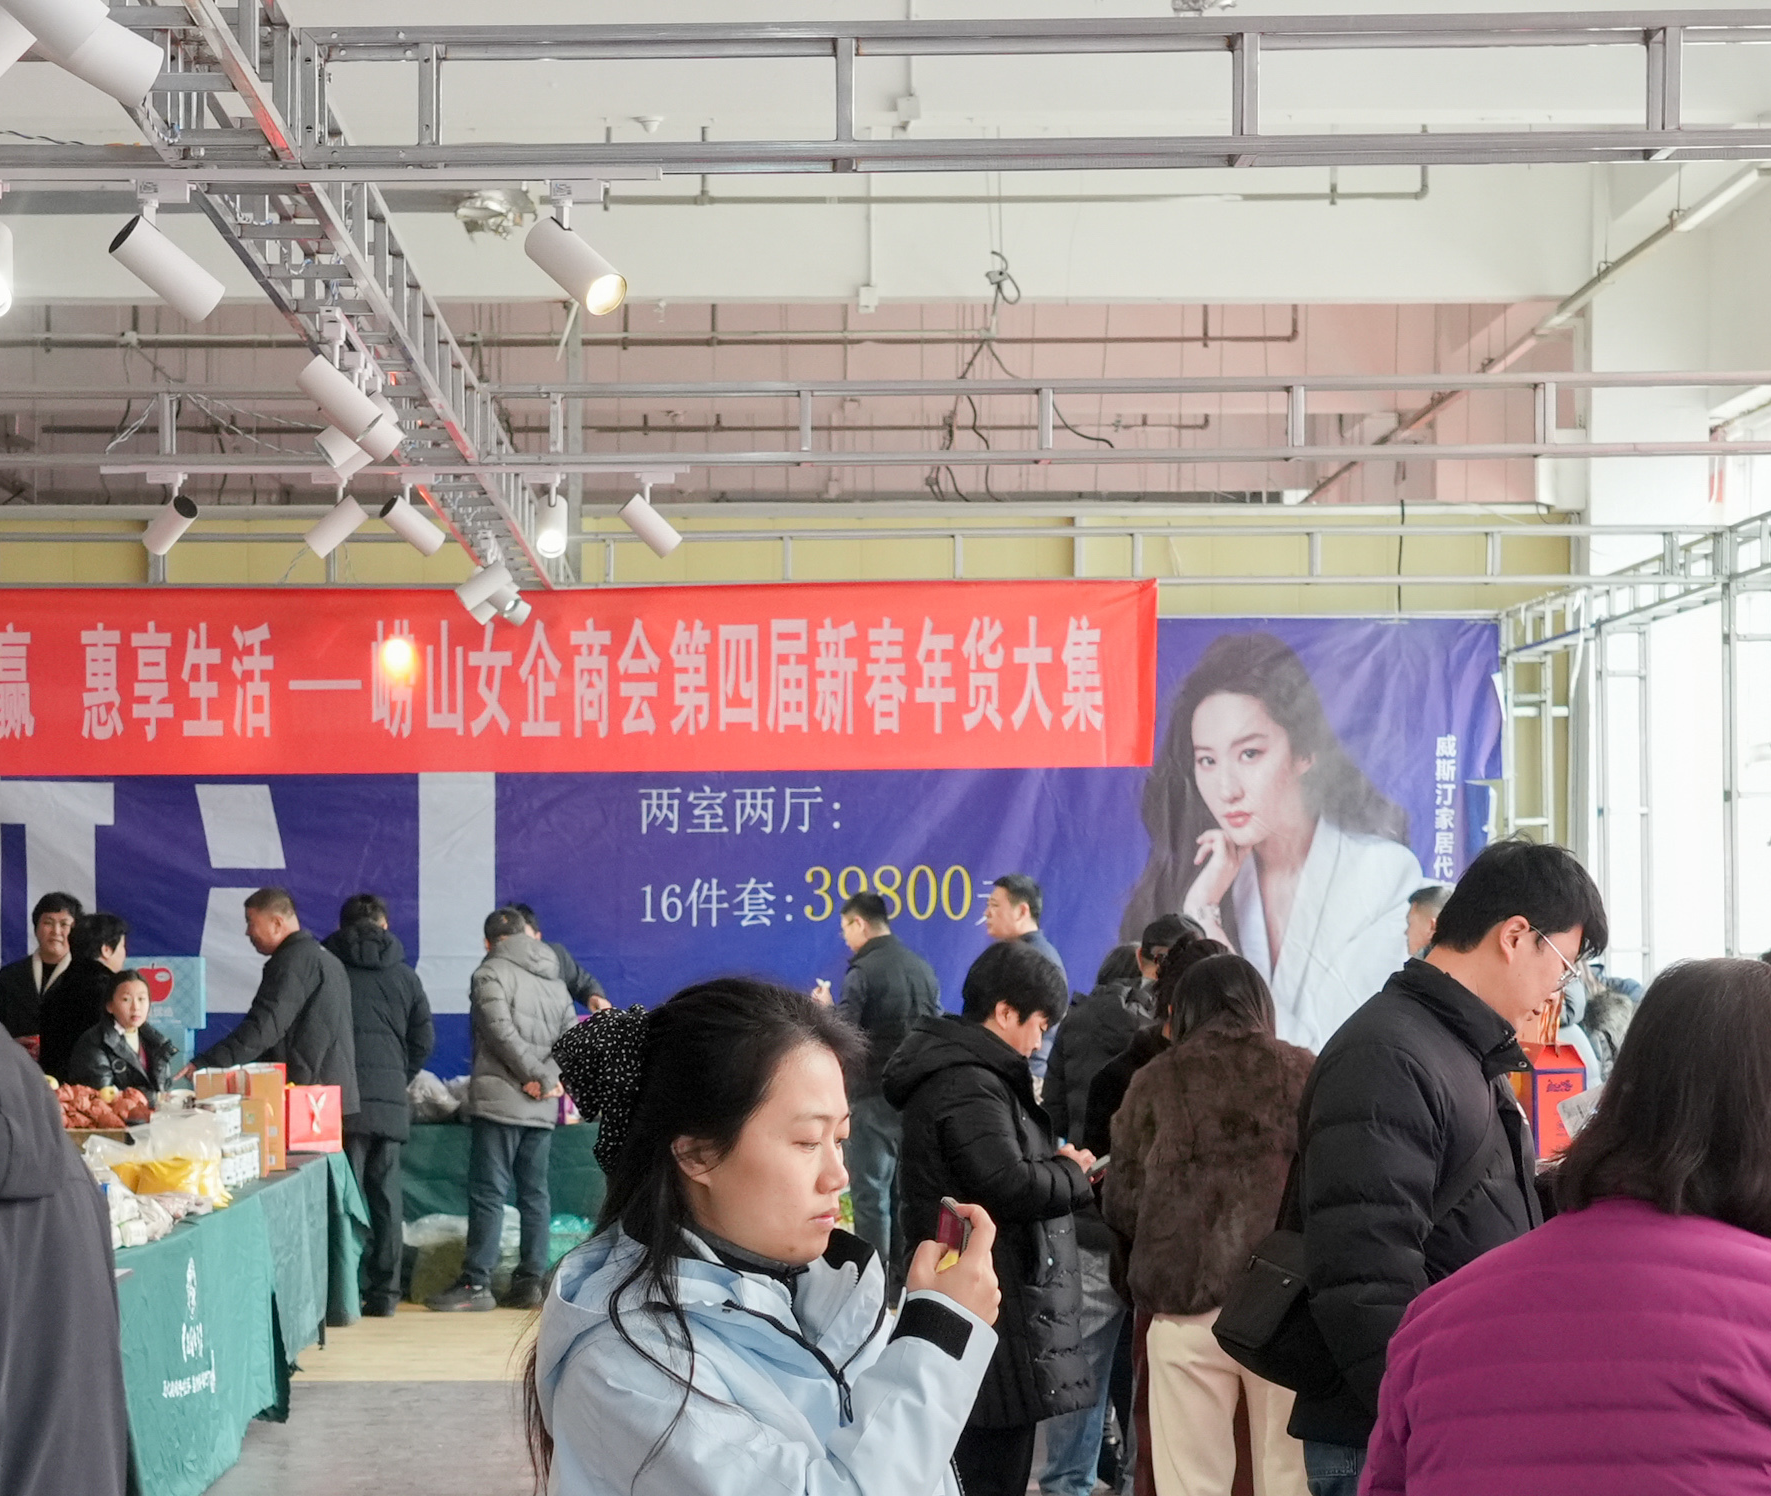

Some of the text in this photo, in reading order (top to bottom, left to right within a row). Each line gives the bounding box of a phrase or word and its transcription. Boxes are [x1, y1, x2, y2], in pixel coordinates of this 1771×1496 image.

[1433, 734, 1457, 887] 威斯汀家居代
